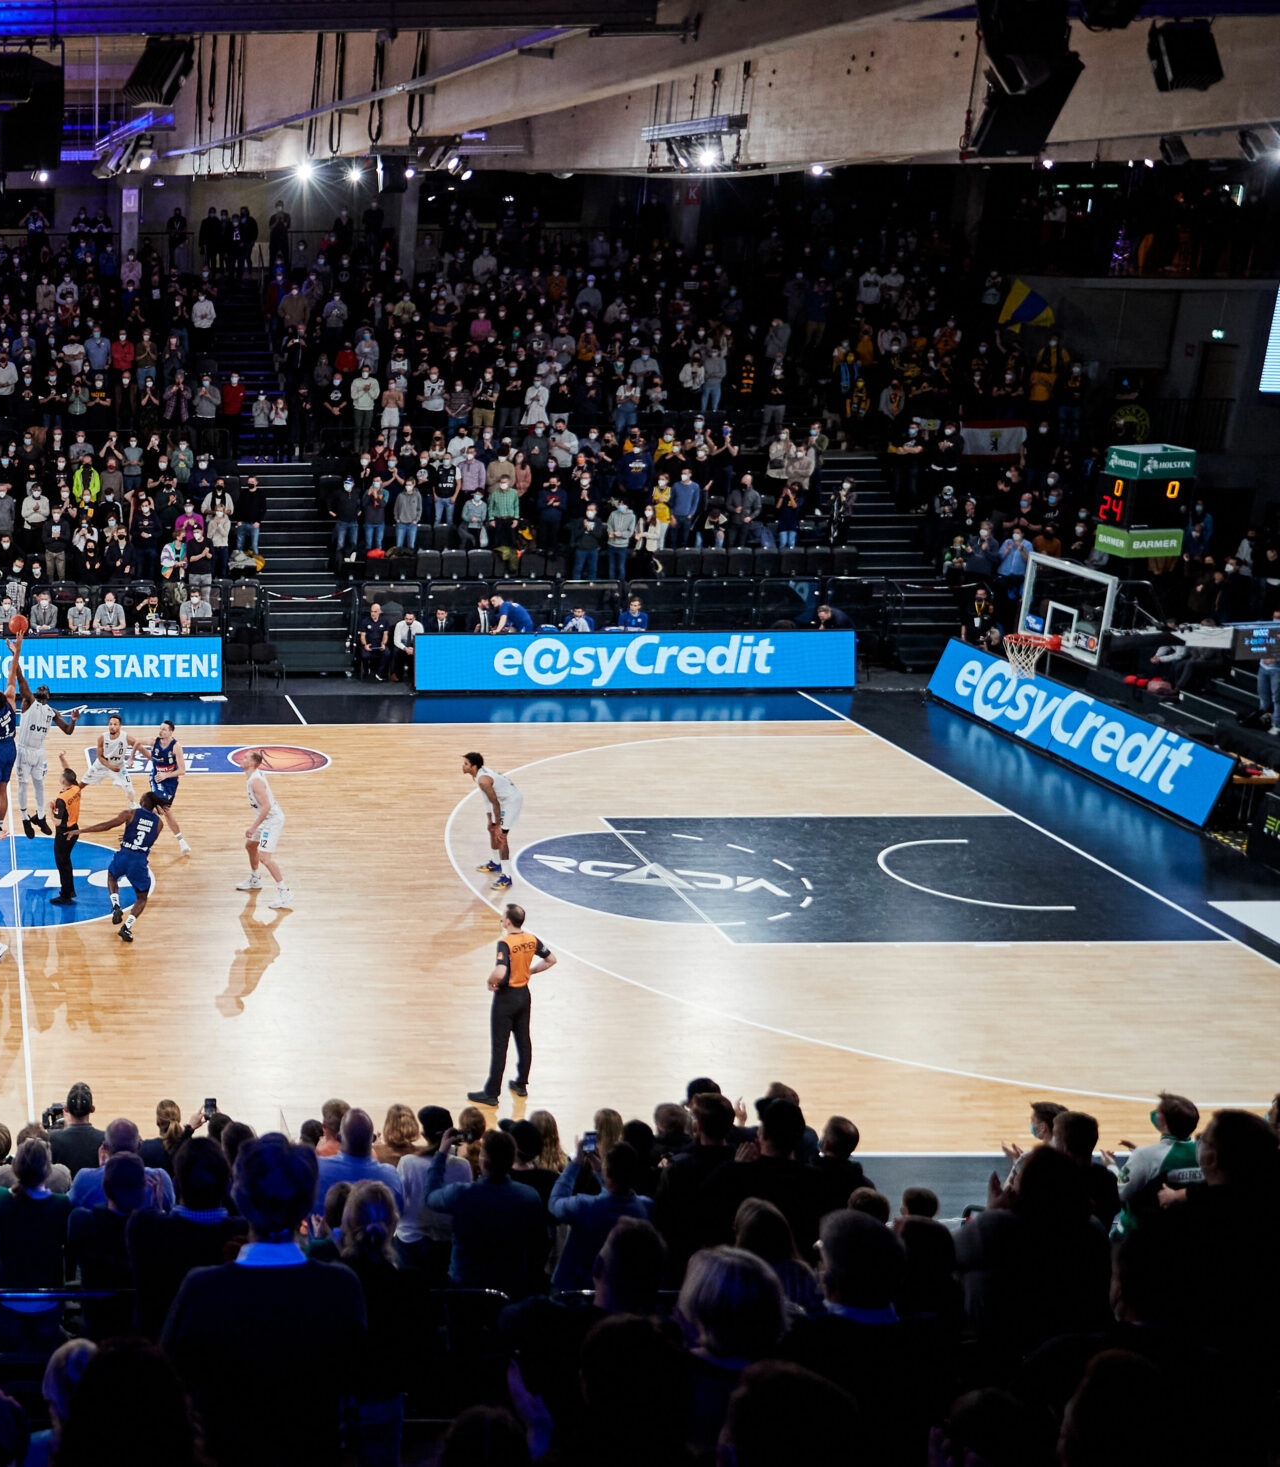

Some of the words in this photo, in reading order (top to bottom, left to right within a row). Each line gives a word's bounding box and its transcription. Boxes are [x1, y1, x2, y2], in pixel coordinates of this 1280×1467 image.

[1159, 461, 1191, 469] HOLSTEN
[1114, 480, 1124, 496] 0
[1166, 481, 1180, 498] 0
[1099, 495, 1122, 522] 24
[1098, 534, 1125, 548] BARMER
[1132, 539, 1177, 549] BARMER
[94, 653, 218, 678] STARTEN!
[133, 831, 146, 846] 3
